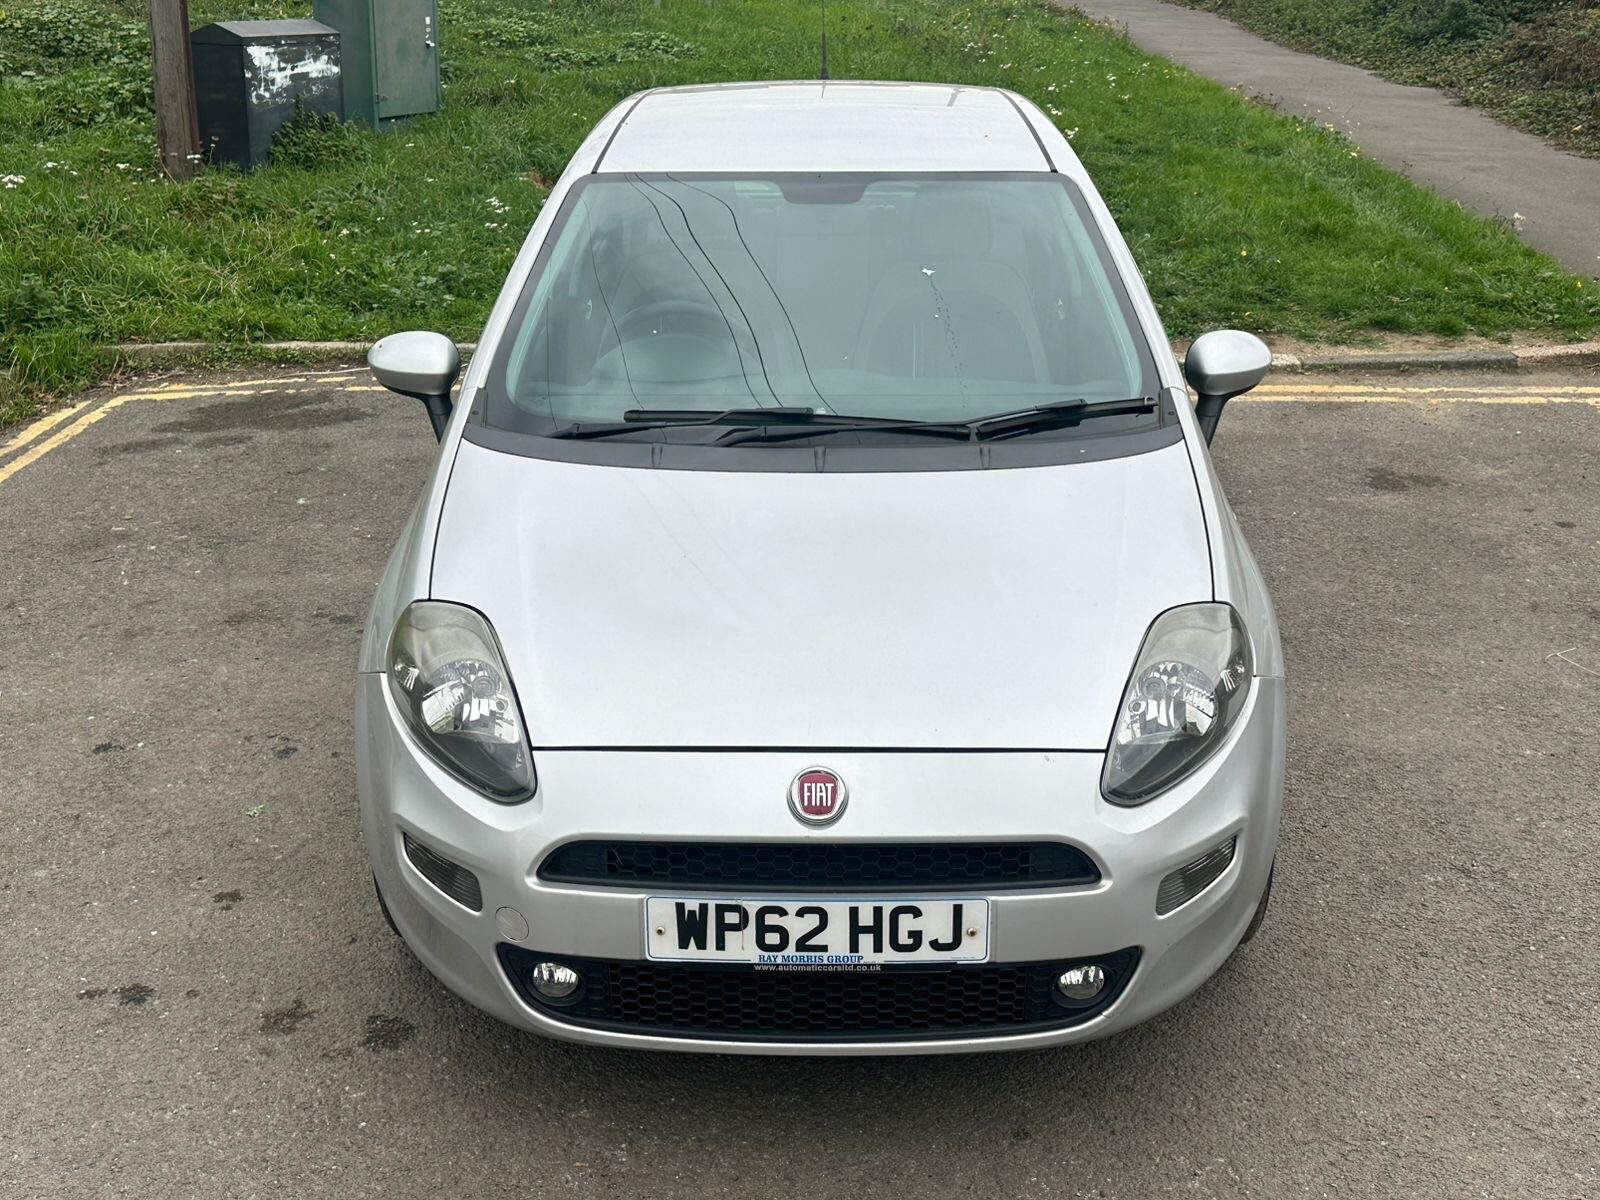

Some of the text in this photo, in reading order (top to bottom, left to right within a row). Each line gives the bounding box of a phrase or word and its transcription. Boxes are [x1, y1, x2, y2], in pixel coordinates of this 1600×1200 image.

[803, 782, 834, 807] FIAT
[675, 901, 963, 953] WP62 HGJ
[758, 954, 864, 964] RAY MORRIS GROUP
